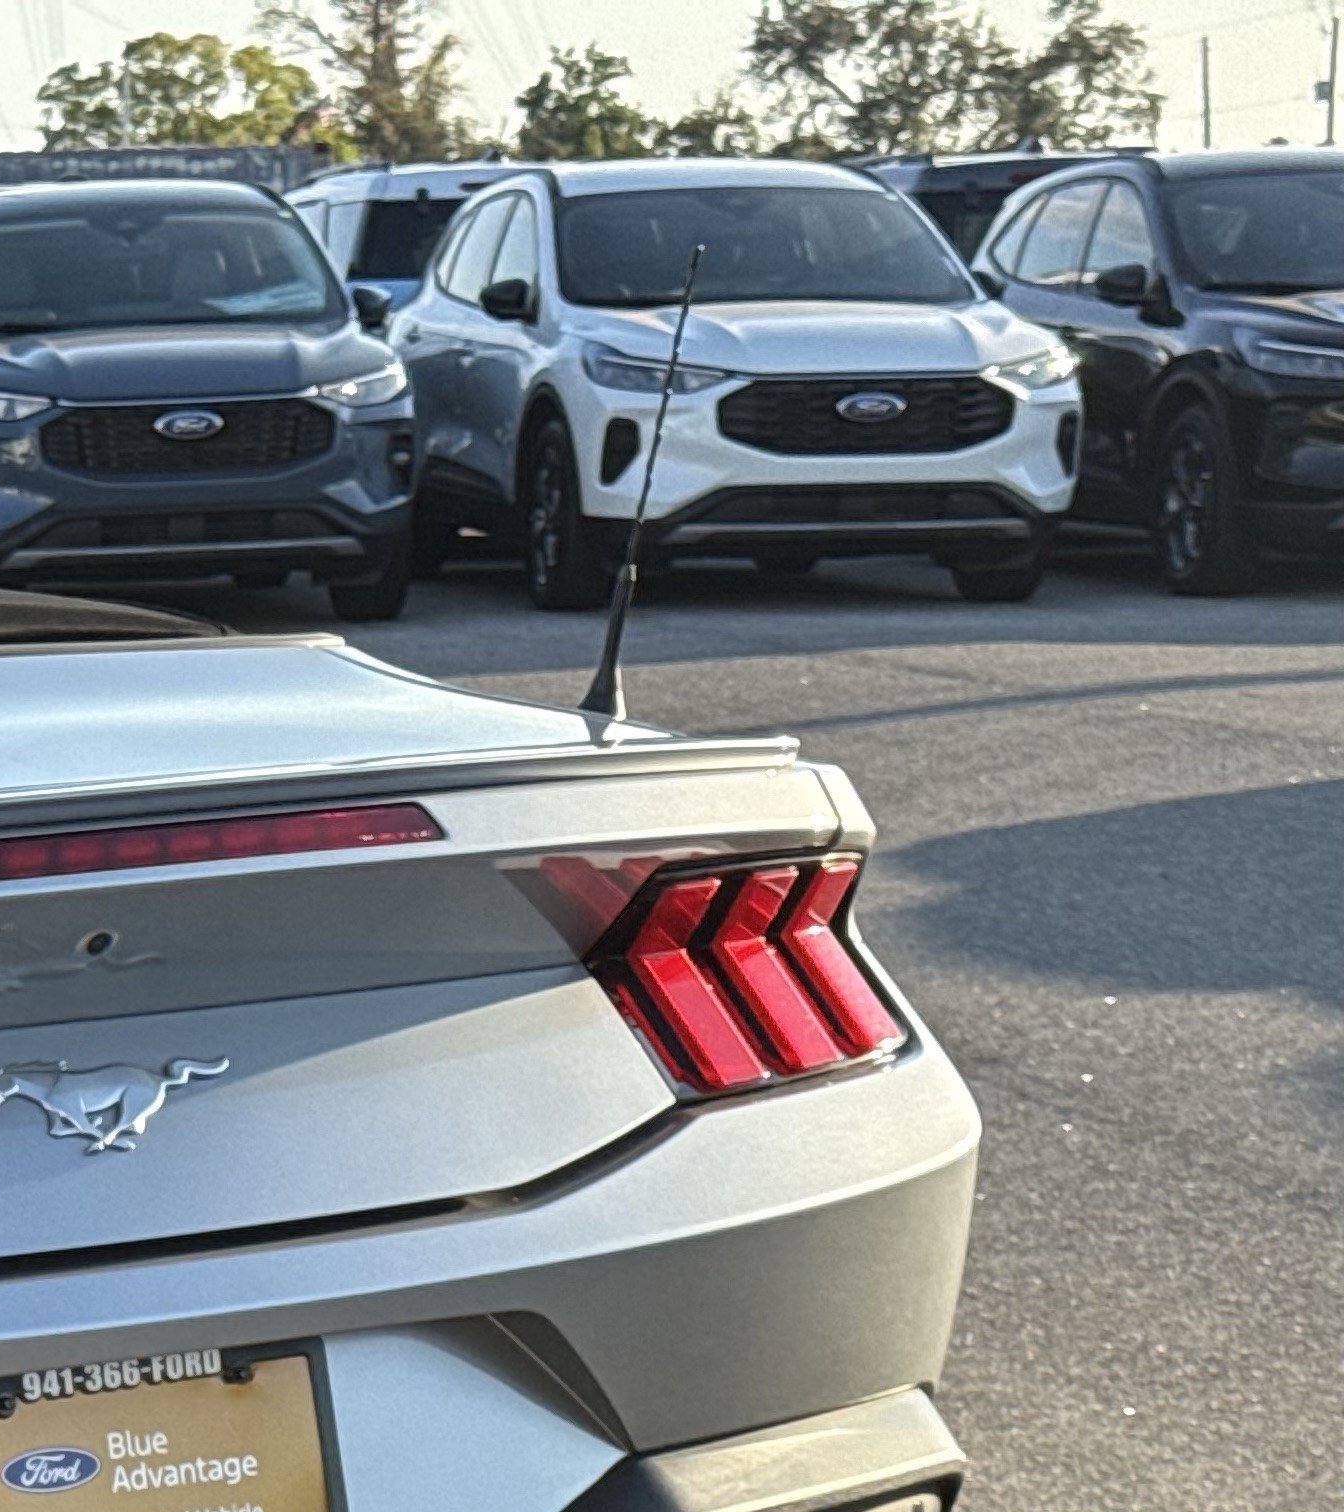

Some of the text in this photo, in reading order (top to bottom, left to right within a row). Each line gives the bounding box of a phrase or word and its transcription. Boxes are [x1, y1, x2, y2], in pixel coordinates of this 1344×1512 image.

[21, 1348, 222, 1401] 941-366-FORD
[106, 1430, 168, 1459] Blue
[20, 1453, 81, 1486] Ford
[111, 1454, 258, 1493] Advantage
